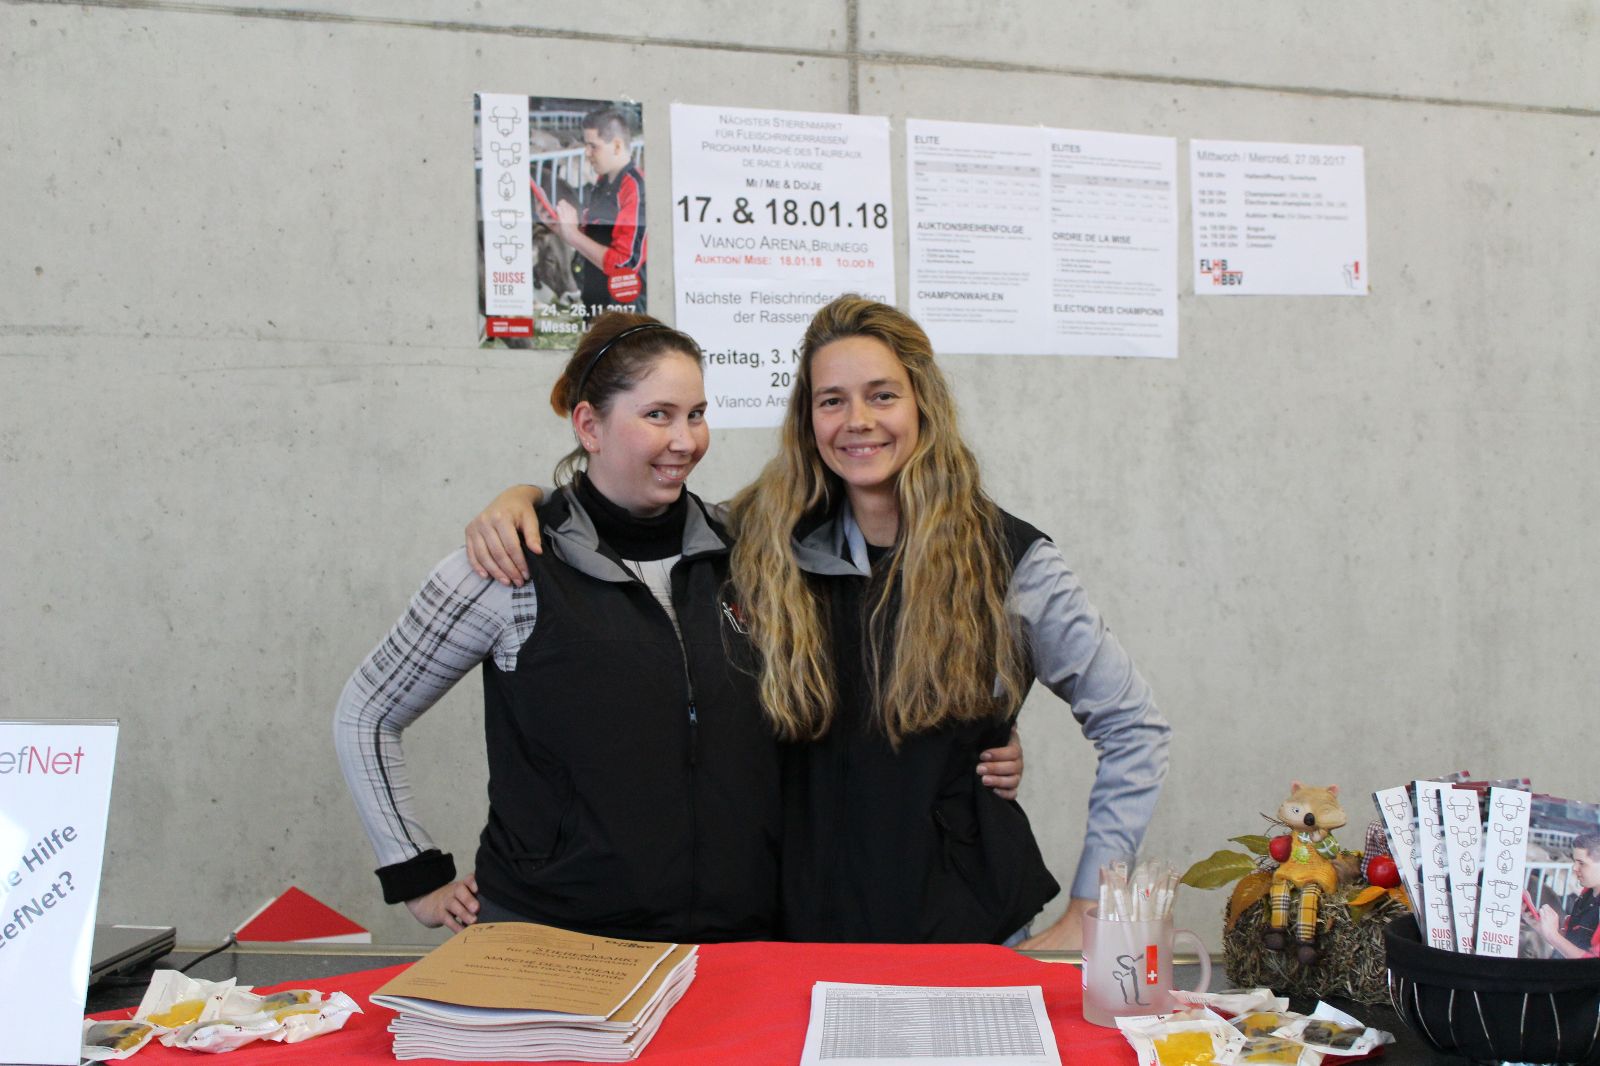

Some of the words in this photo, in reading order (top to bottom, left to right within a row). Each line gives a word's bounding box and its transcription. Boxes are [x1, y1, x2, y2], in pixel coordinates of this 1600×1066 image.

[914, 134, 940, 145] ELITE
[794, 147, 812, 157] DES
[1197, 150, 1240, 162] Mittwoch
[742, 159, 755, 168] DE
[757, 159, 780, 169] RACE
[677, 195, 722, 223] 17.
[732, 197, 755, 224] &
[765, 198, 888, 229] 18.01.18
[917, 222, 1024, 234] AUKTIONSREIHENFOLGE
[700, 234, 756, 249] VIANCO
[1052, 231, 1082, 242] ORDRE
[1085, 233, 1096, 243] DE
[1098, 234, 1109, 243] LA
[1111, 235, 1131, 245] MISE
[780, 255, 823, 267] 18.01.18
[493, 271, 526, 285] SUISSE
[493, 284, 514, 296] TIER
[917, 289, 1004, 302] CHAMPIONWAHLEN
[685, 291, 742, 305] Nächste
[1053, 302, 1095, 314] ELECTION
[1097, 305, 1114, 315] DES
[1115, 306, 1164, 317] CHAMPIONS
[733, 310, 755, 324] der
[541, 320, 578, 334] Messe
[771, 348, 786, 365] 3.
[771, 372, 797, 388] 20
[715, 395, 762, 409] Vianco
[766, 395, 789, 408] Are
[22, 825, 78, 873] Hilfe
[1432, 927, 1452, 940] SUIS
[1482, 931, 1514, 946] SUISSE
[1482, 941, 1502, 955] TIER
